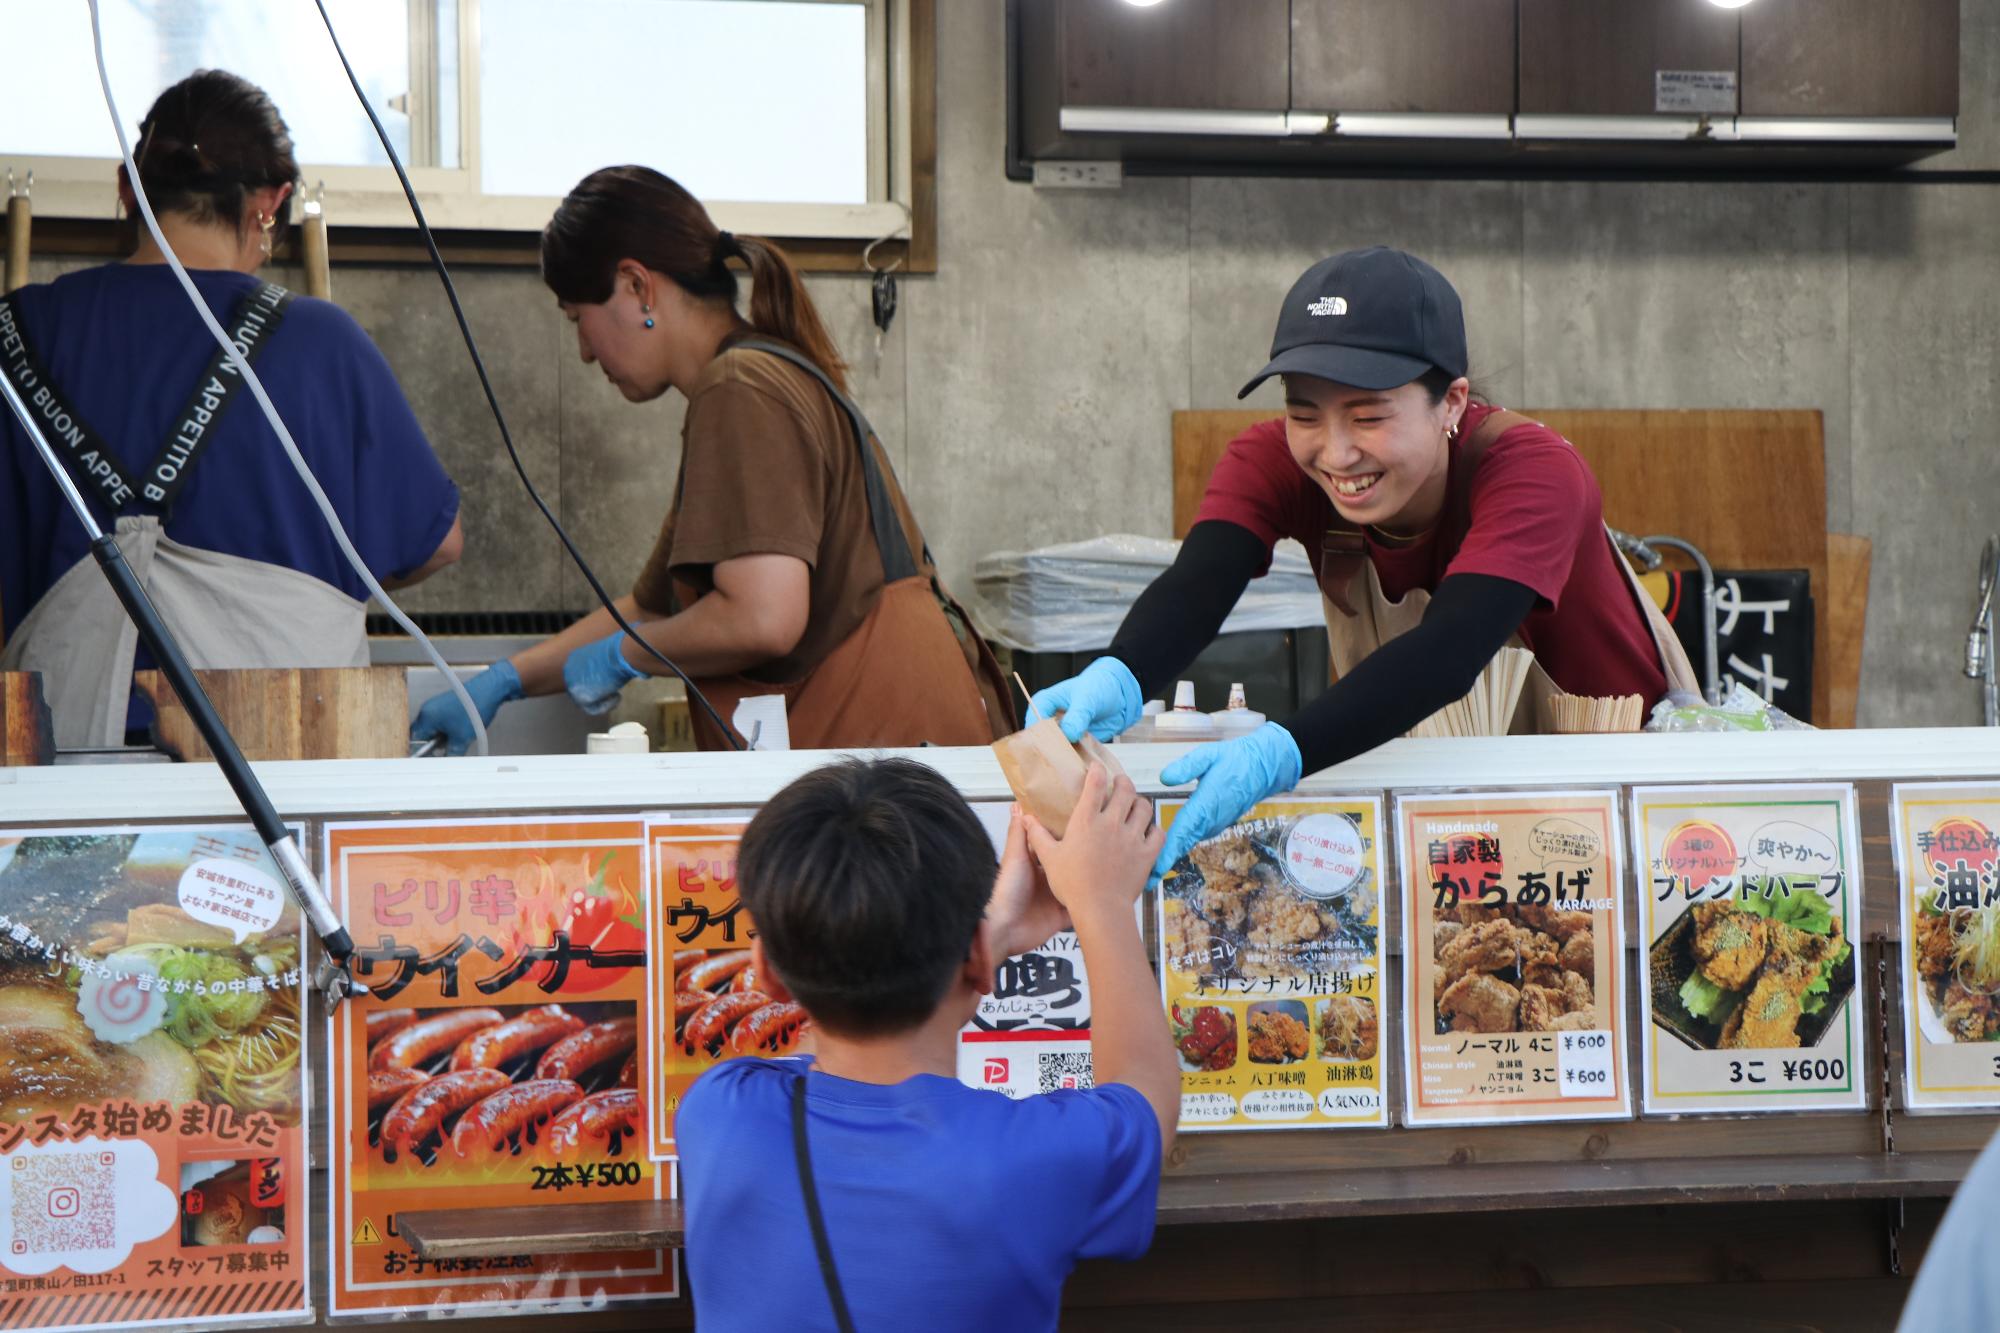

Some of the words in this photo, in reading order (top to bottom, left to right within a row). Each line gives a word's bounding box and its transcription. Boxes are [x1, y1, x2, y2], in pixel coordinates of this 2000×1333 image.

[1307, 303, 1334, 311] NORTH
[1320, 296, 1336, 304] THE
[33, 386, 86, 449] BUON
[156, 376, 227, 482] APPETITO
[1426, 822, 1499, 834] Handmade
[1428, 838, 1502, 865] 自家製
[1432, 867, 1594, 910] からあげ
[1653, 871, 1845, 902] ブレンドハーブ
[374, 874, 517, 926] ピリ辛
[1554, 897, 1614, 911] KARAAGE
[667, 898, 759, 944] ウイ
[1169, 944, 1238, 972] まずはコレ
[137, 967, 302, 995] 昔ながらの中華そば
[1192, 972, 1377, 996] オリジナル唐揚げ
[982, 1000, 1048, 1014] あんじょう
[1457, 1039, 1520, 1055] ノーマル
[1529, 1038, 1553, 1052] 4こ
[1181, 1075, 1236, 1086] ンニョム
[1250, 1071, 1306, 1086] 八丁味噌
[1326, 1065, 1374, 1082] 油淋鶏
[1532, 1068, 1556, 1082] 3こ
[1729, 1061, 1766, 1083] 3こ
[1783, 1059, 1845, 1081] ¥600
[1479, 1085, 1524, 1095] ヤンニョム
[147, 1251, 290, 1277] スタッフ募集中
[0, 1273, 126, 1293] 里町東山ノ田117-1
